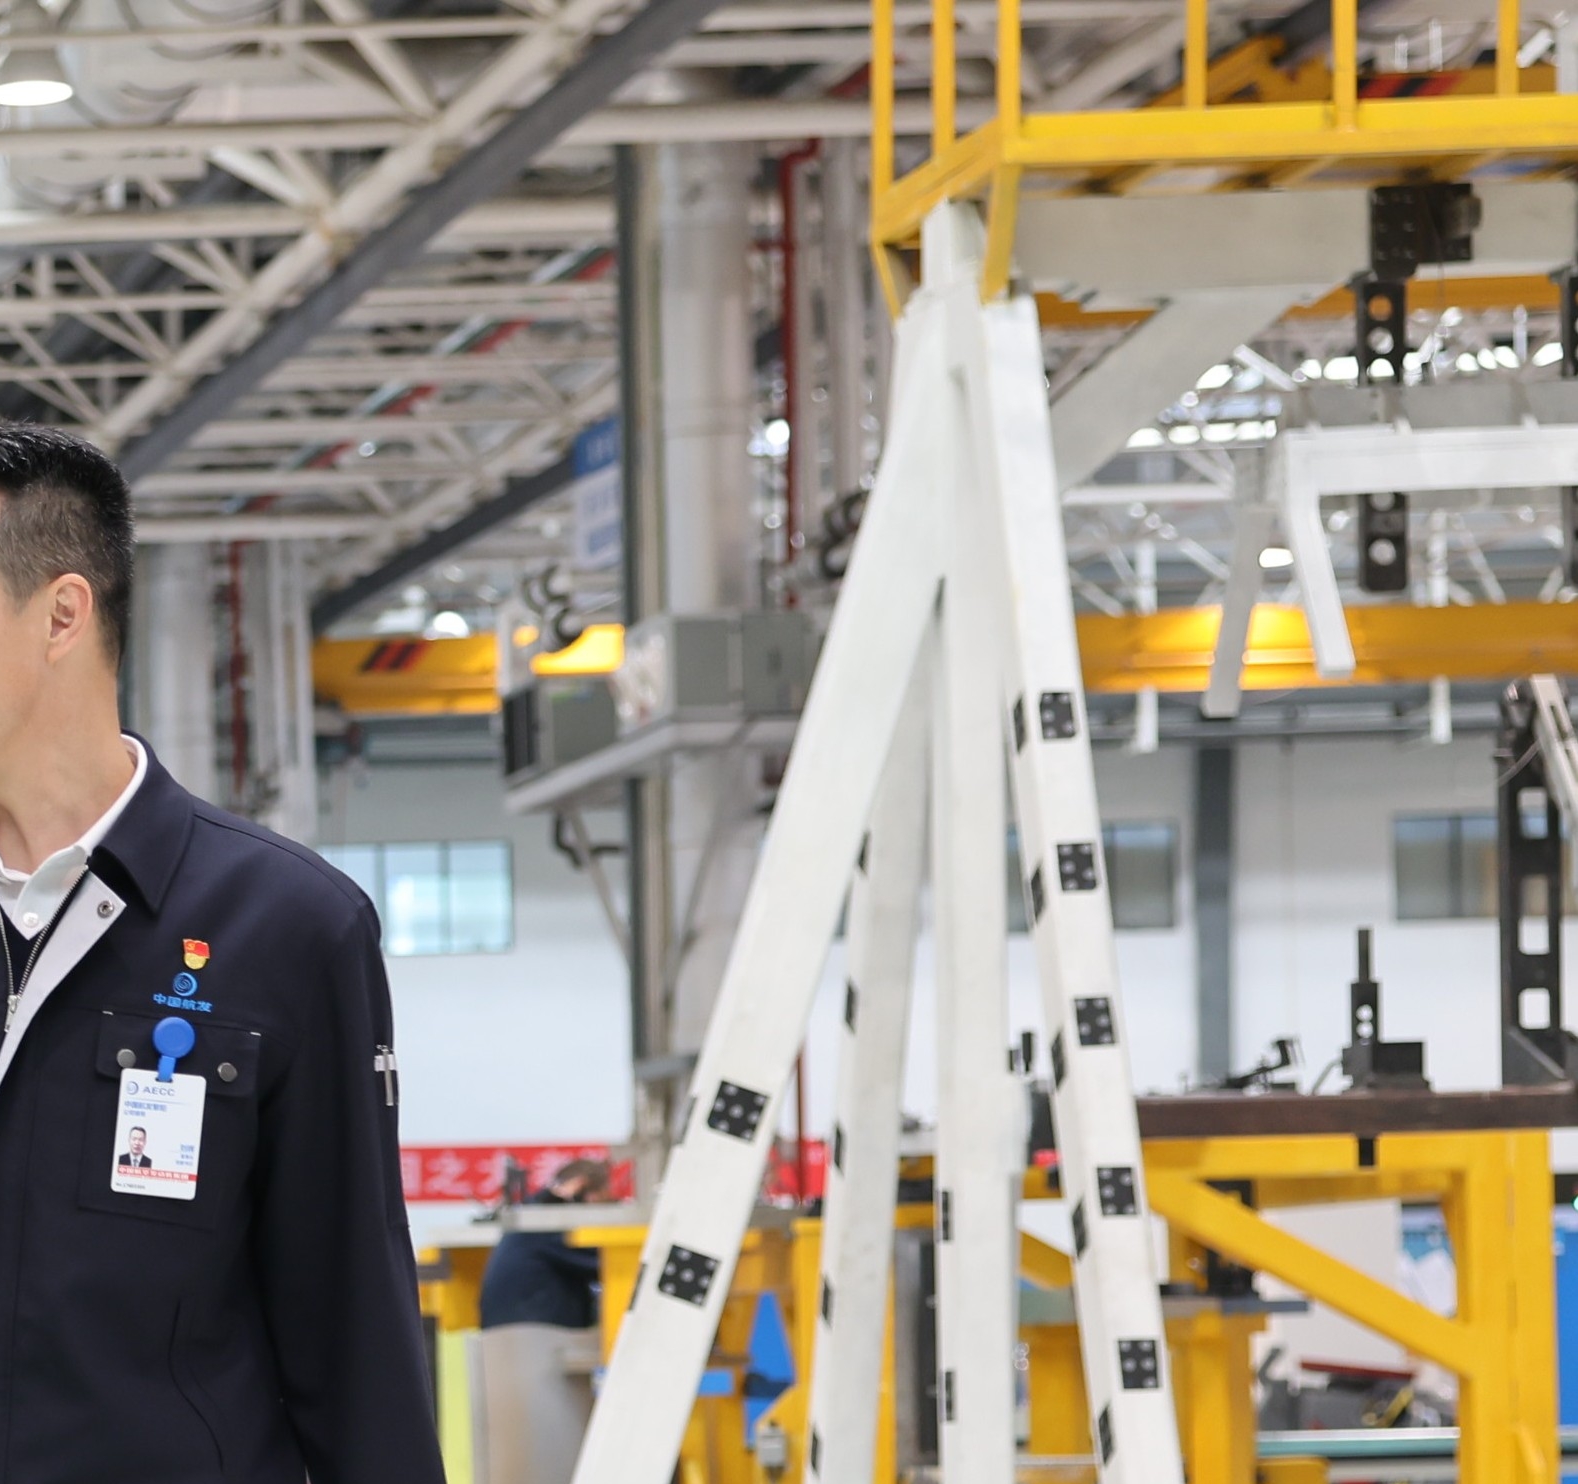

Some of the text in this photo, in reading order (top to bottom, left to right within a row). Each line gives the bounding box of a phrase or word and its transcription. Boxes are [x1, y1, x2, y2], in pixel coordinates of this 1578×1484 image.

[153, 993, 213, 1012] 中国航发
[142, 1085, 175, 1097] AECC
